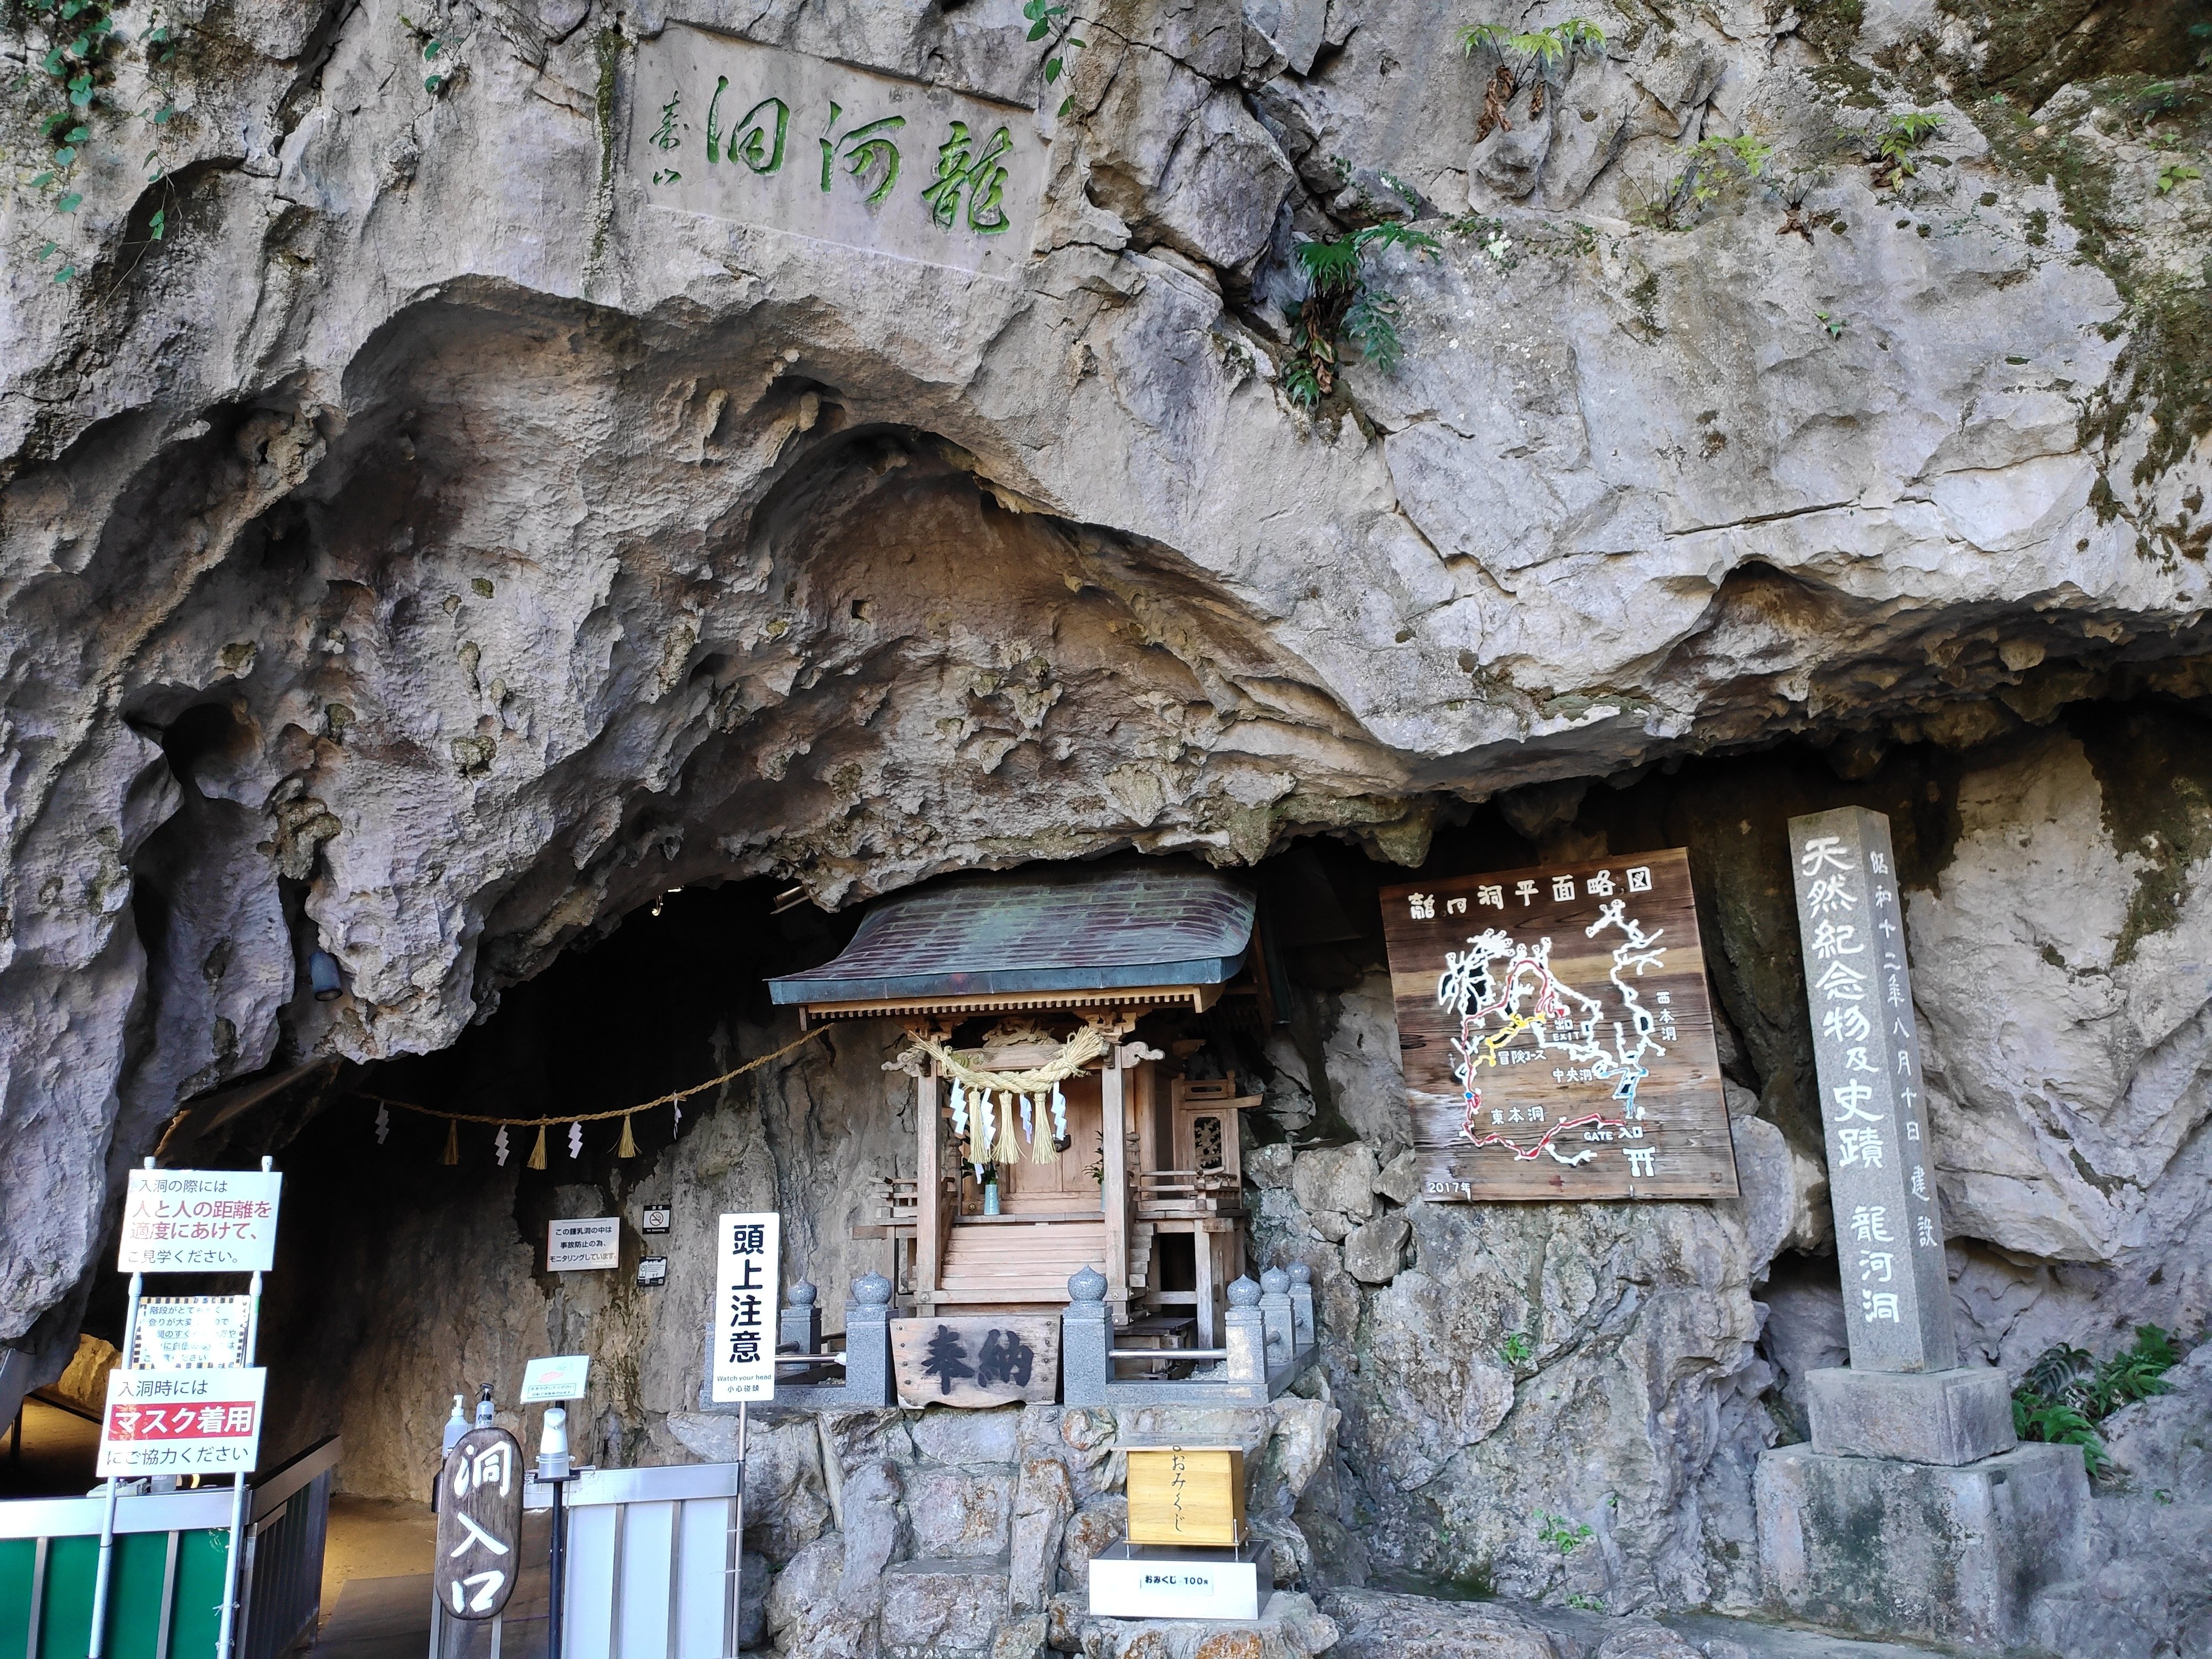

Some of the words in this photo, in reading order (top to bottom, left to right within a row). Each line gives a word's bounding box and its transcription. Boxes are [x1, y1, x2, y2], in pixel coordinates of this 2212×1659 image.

[1554, 1019, 1573, 1030] 出口
[1656, 991, 1678, 1041] 西本洞
[1553, 1031, 1579, 1041] EXIT
[1498, 1050, 1547, 1065] 冒険コース
[1552, 1066, 1593, 1083] 中央洞
[1490, 1106, 1545, 1125] 東本洞
[1584, 1130, 1613, 1142] GATE
[1618, 1126, 1644, 1139] 入口
[138, 1179, 228, 1193] 入洞の際には
[1428, 1182, 1471, 1200] 2017年
[132, 1200, 272, 1219] 人と人の距離を
[1911, 1165, 1937, 1247] 建設
[130, 1221, 257, 1240] 適度にあけて、
[560, 1240, 606, 1249] 事故防止の為、
[1851, 1206, 1900, 1323] 龍河洞
[730, 1224, 764, 1363] 頭上注意
[921, 1324, 1034, 1395] 奉納
[118, 1380, 208, 1397] 入洞時には
[115, 1405, 252, 1434] マスク着用
[107, 1446, 248, 1465] にご協力ください
[1171, 1455, 1186, 1533] おみくじ
[450, 1441, 512, 1614] 洞入口
[1145, 1575, 1177, 1584] おみくじ
